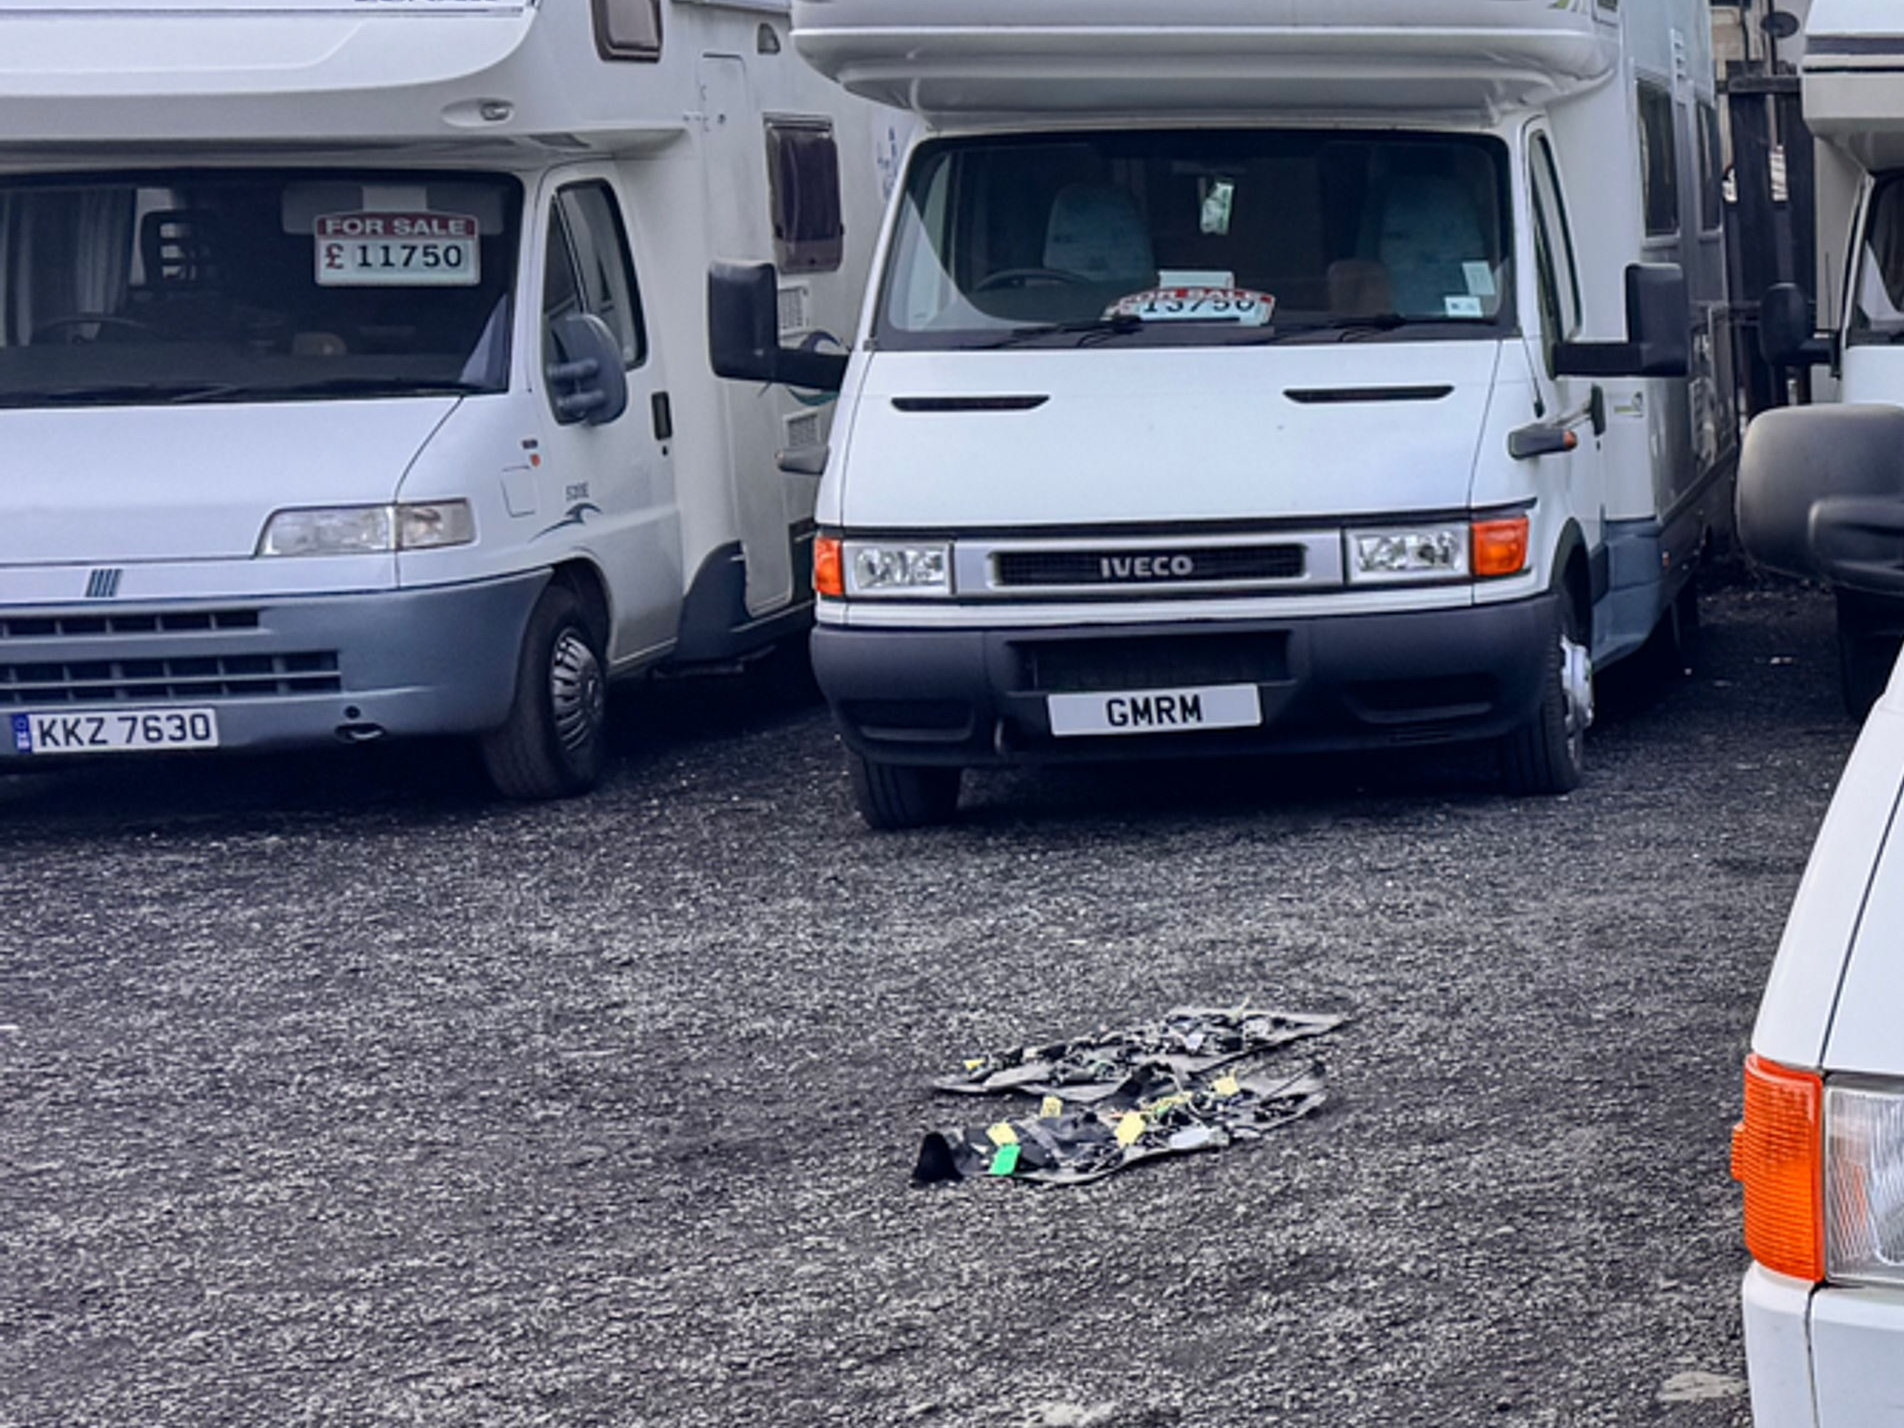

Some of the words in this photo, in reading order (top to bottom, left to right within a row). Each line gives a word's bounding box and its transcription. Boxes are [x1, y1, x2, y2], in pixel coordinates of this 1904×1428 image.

[325, 219, 383, 235] FOR
[394, 218, 465, 235] SALE
[1101, 556, 1193, 578] IVECO
[1106, 694, 1202, 727] GMRM
[38, 717, 108, 747] KKZ
[117, 713, 210, 744] 7630
